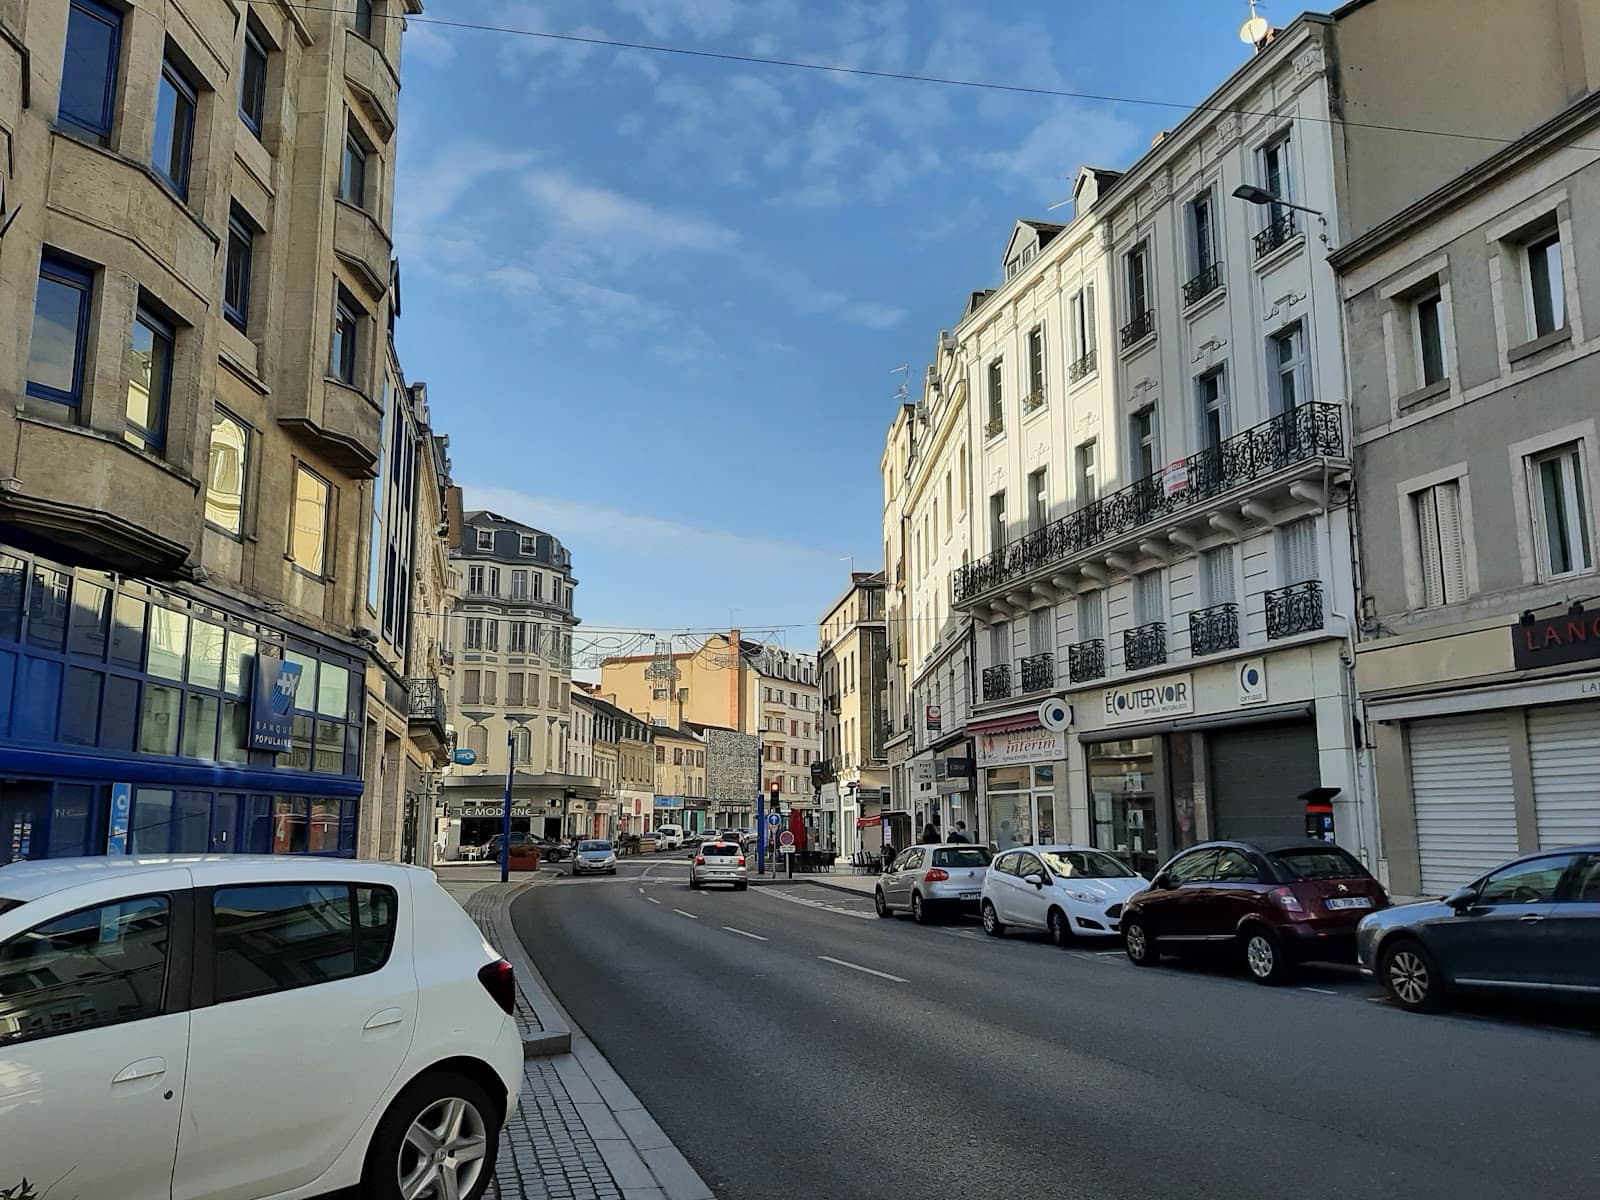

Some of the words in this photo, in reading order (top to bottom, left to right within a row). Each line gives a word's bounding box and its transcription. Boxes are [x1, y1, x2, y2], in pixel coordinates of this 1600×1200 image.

[1581, 682, 1600, 694] LA
[1106, 688, 1156, 716] ÉCOUTER
[1156, 682, 1187, 705] VOIR
[256, 720, 292, 735] BANQUE
[255, 734, 292, 748] POPULAIRE
[475, 807, 533, 817] MODRNE
[1324, 817, 1331, 828] P
